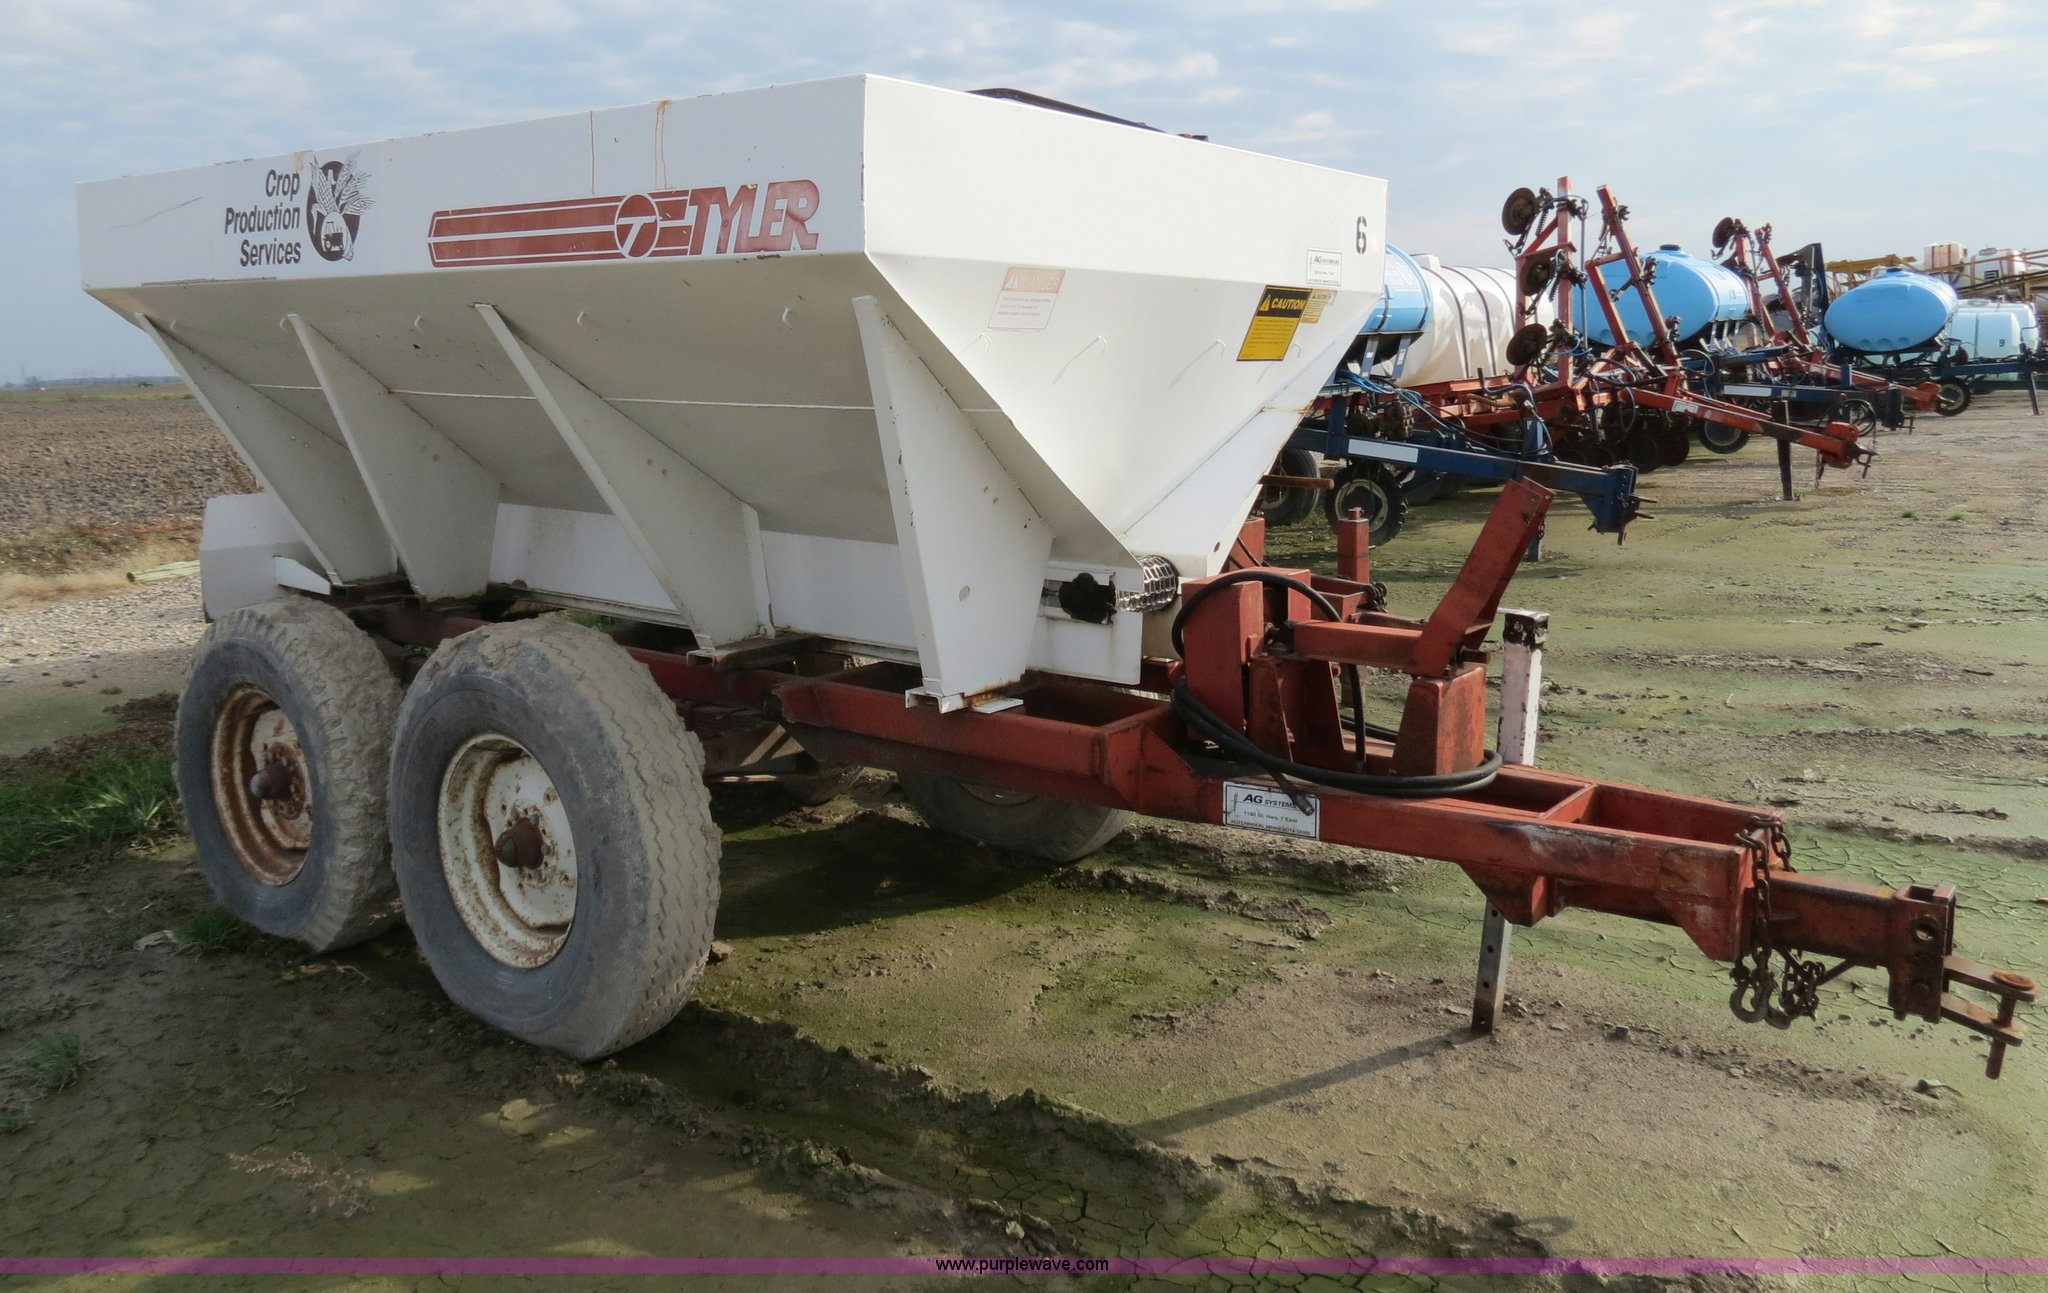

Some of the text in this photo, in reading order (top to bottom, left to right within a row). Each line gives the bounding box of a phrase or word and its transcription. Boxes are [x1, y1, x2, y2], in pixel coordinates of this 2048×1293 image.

[265, 169, 300, 201] Crop
[225, 202, 300, 234] Production
[688, 179, 820, 255] TYLER
[1356, 216, 1367, 254] 6
[240, 238, 301, 267] Services
[1271, 297, 1306, 310] CAUTION
[1243, 794, 1264, 804] AG
